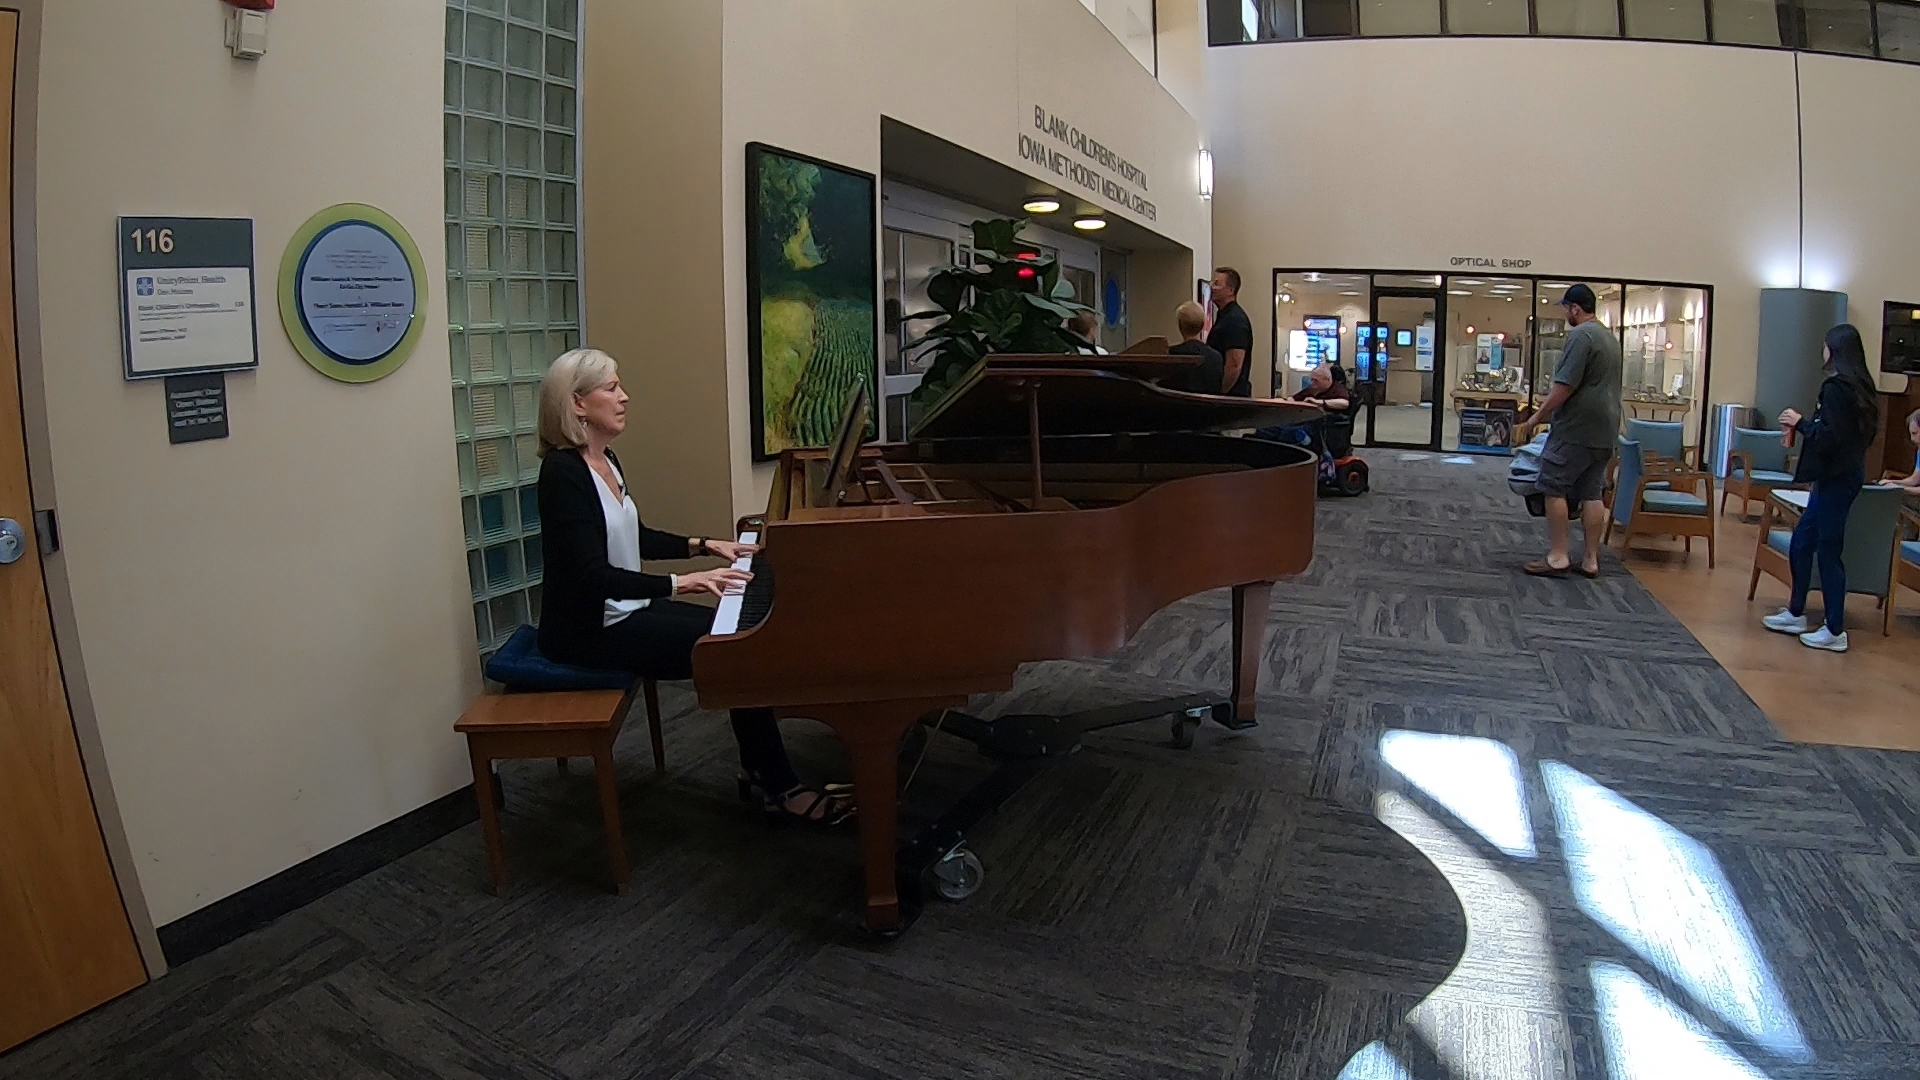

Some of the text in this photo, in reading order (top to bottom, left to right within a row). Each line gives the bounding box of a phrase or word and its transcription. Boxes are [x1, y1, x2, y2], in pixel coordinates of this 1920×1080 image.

[1034, 104, 1148, 192] BLANK CHILDREN'S HOSPITAL
[1018, 132, 1157, 222] IOWA METHODIST MEDICAL CENTER
[131, 228, 174, 253] 116
[1450, 257, 1532, 268] OPTICAL SHOP
